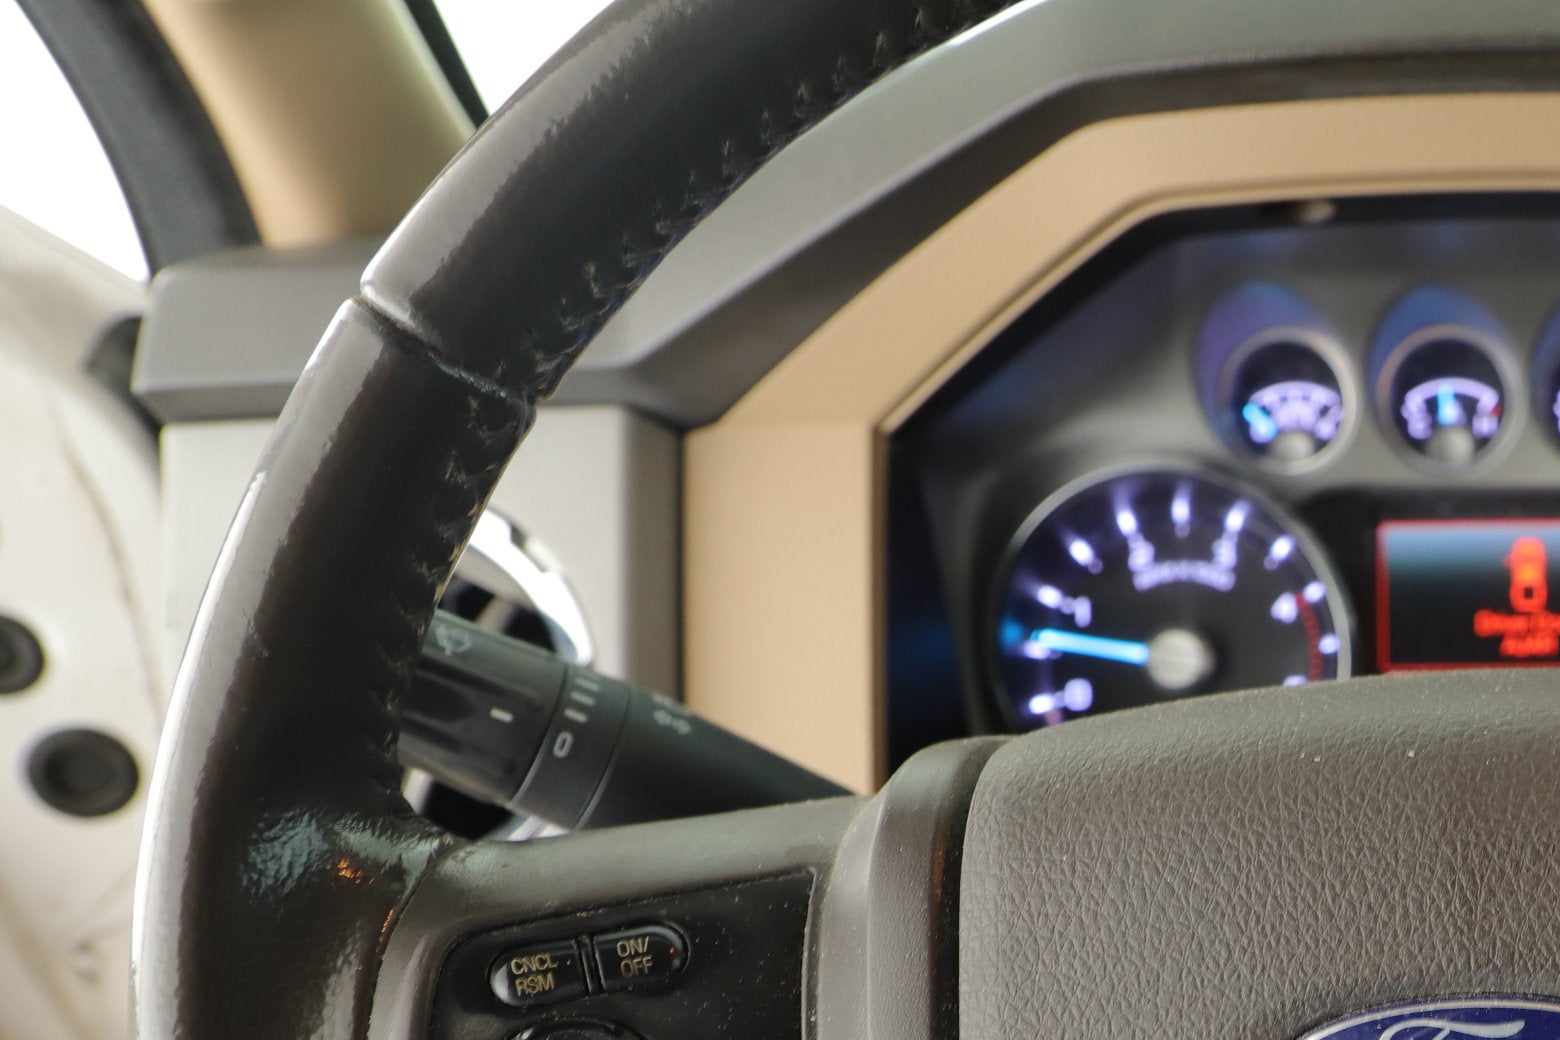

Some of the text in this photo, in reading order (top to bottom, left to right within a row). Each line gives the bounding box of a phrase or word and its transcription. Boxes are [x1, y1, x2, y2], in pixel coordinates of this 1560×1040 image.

[616, 936, 650, 958] ON/
[510, 954, 559, 975] CNCL
[620, 956, 653, 978] OFF
[516, 973, 555, 996] RSM
